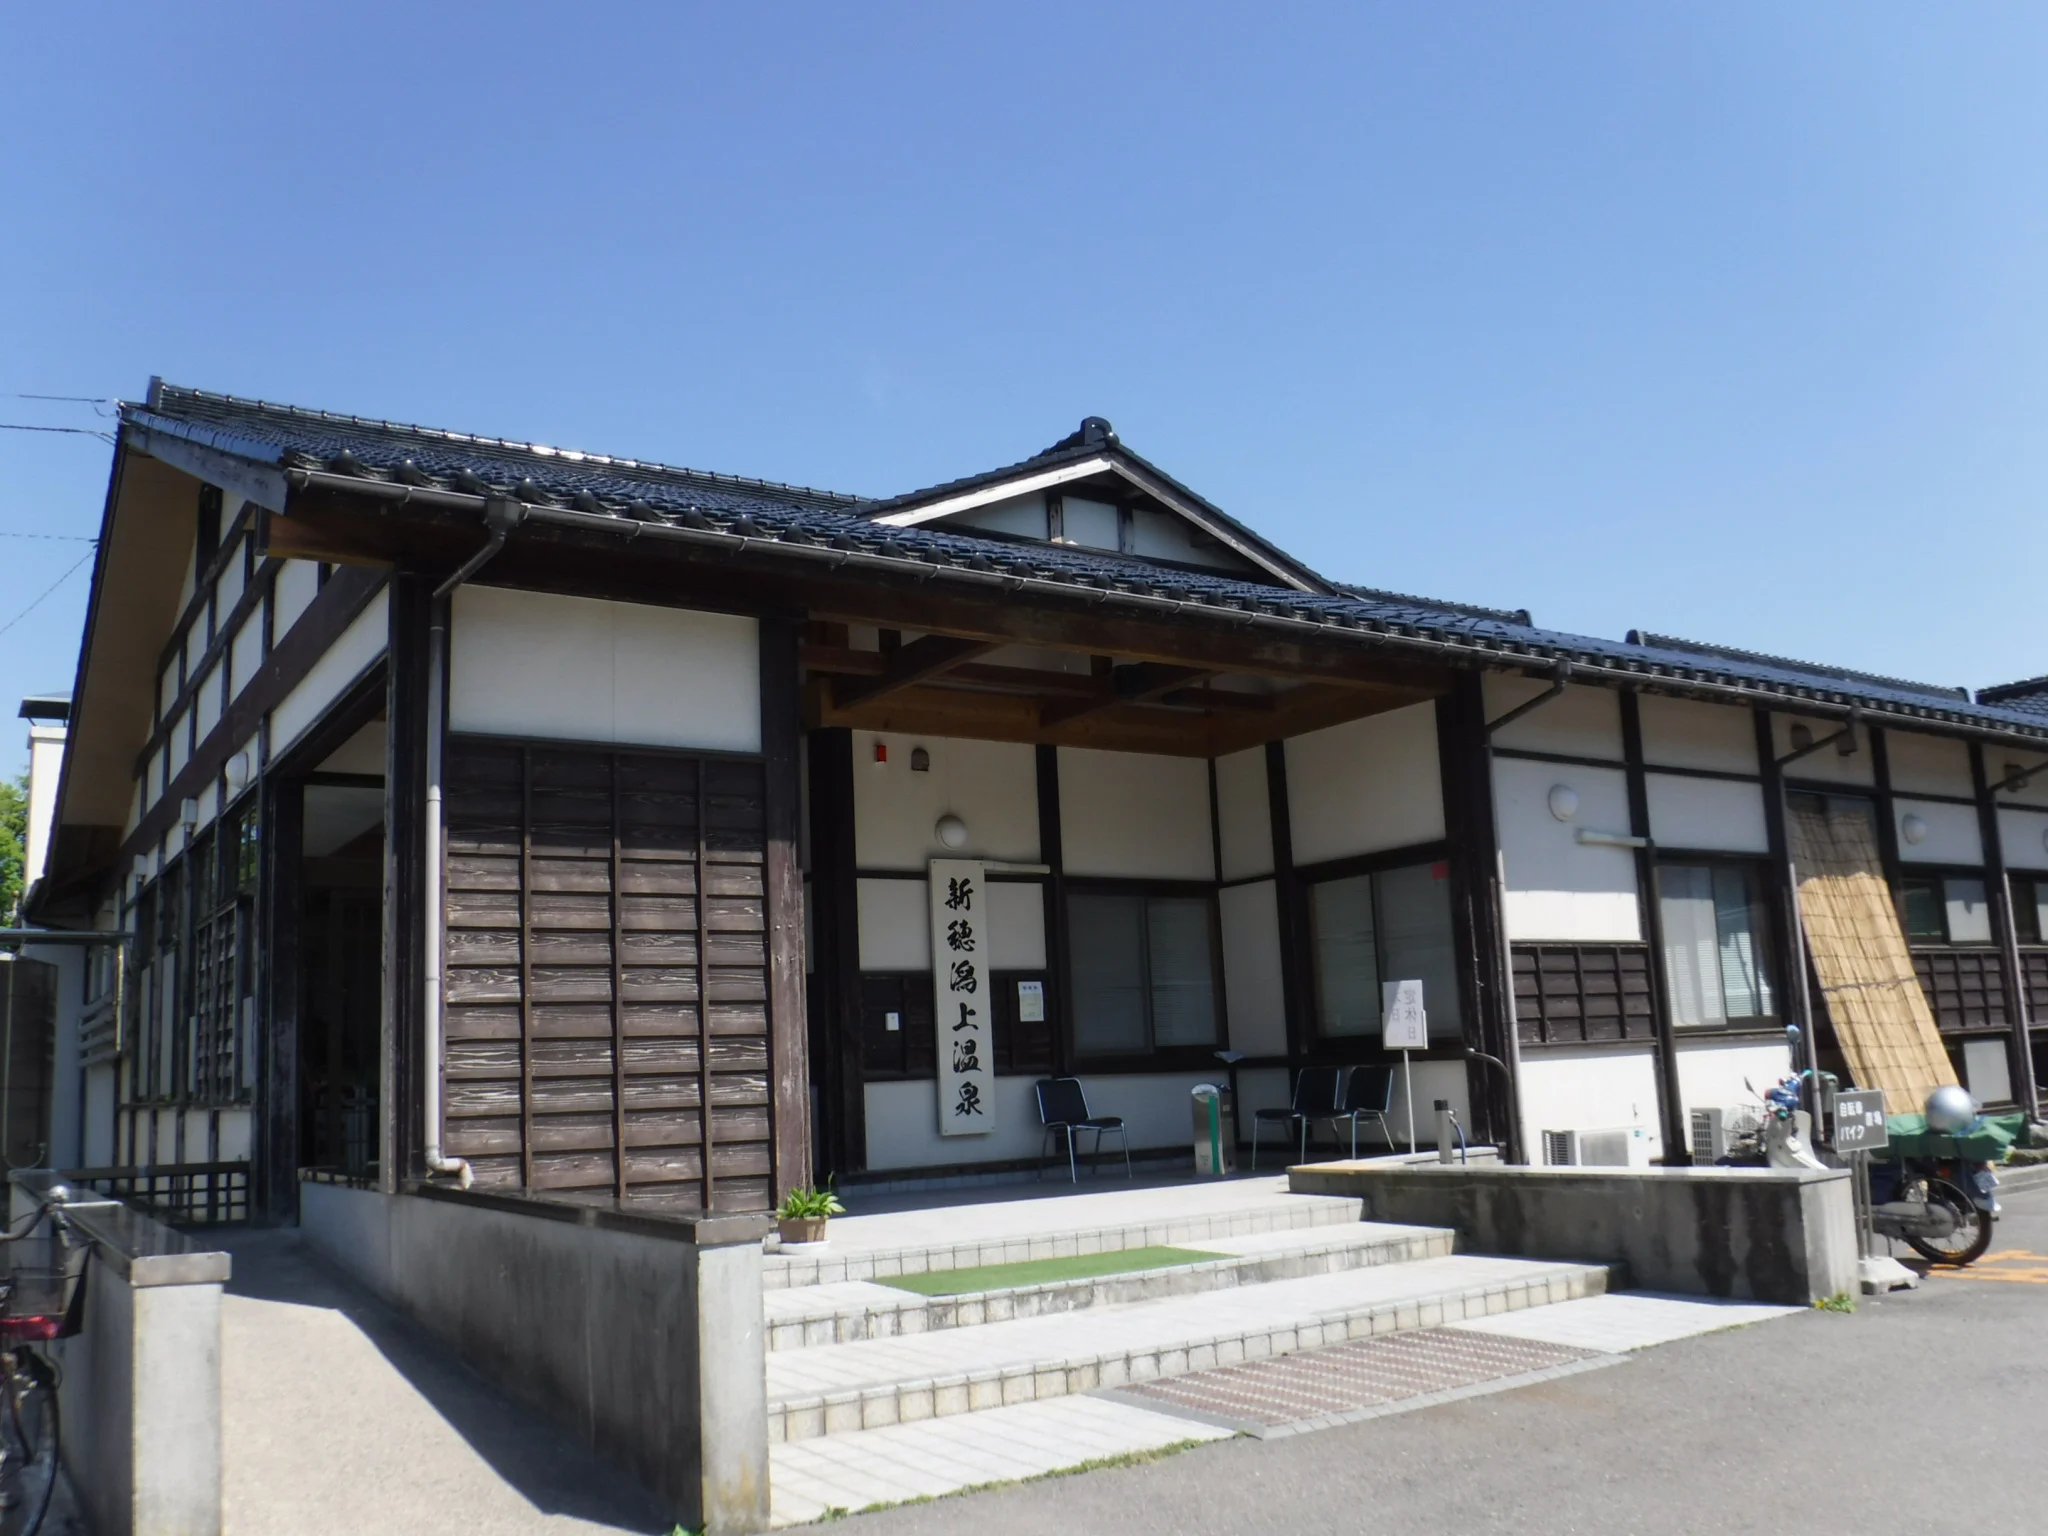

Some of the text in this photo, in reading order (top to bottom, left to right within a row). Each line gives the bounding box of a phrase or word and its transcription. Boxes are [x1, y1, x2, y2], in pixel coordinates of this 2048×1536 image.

[945, 877, 983, 1117] 新穂潟上温泉
[1840, 1124, 1865, 1141] バイク
